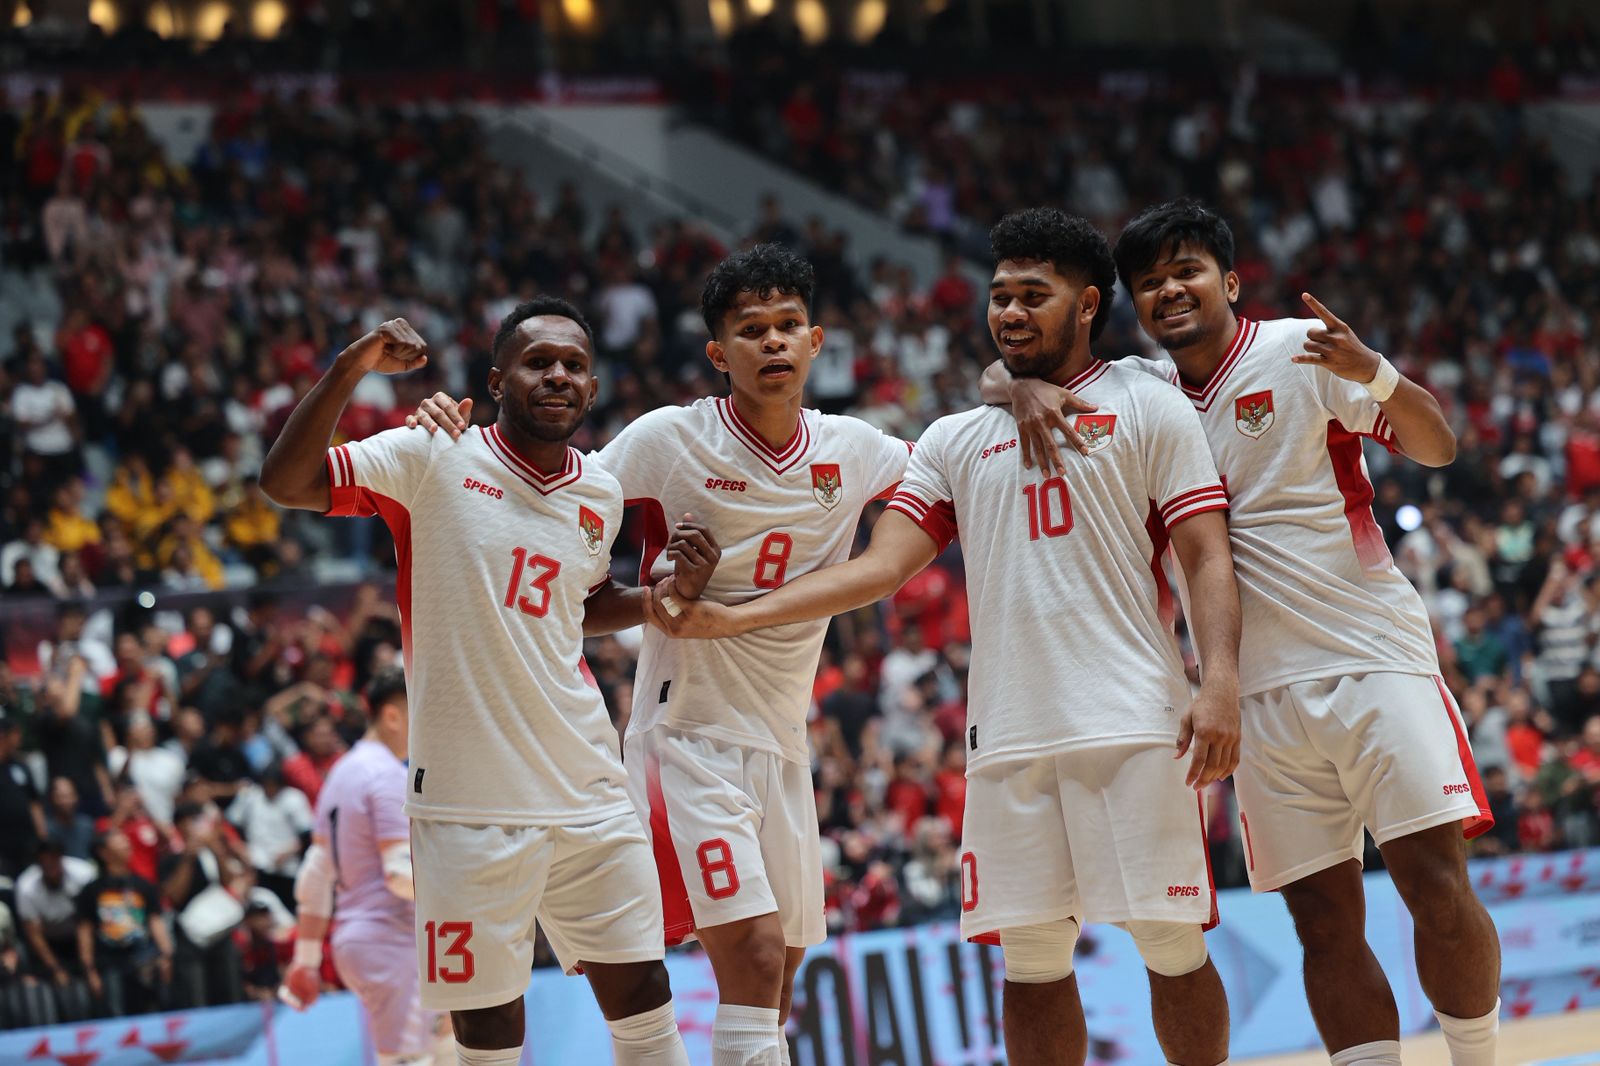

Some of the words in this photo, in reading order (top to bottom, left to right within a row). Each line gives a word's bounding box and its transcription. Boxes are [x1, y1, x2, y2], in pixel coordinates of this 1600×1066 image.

[463, 477, 504, 499] SPECS
[705, 478, 747, 492] SPECS
[1023, 474, 1074, 541] 10
[504, 546, 561, 618] 13
[752, 531, 794, 590] 8
[1443, 783, 1470, 795] SPECS
[696, 837, 740, 900] 8
[961, 851, 979, 912] 0
[1167, 885, 1200, 897] SPECS
[424, 920, 475, 984] 13
